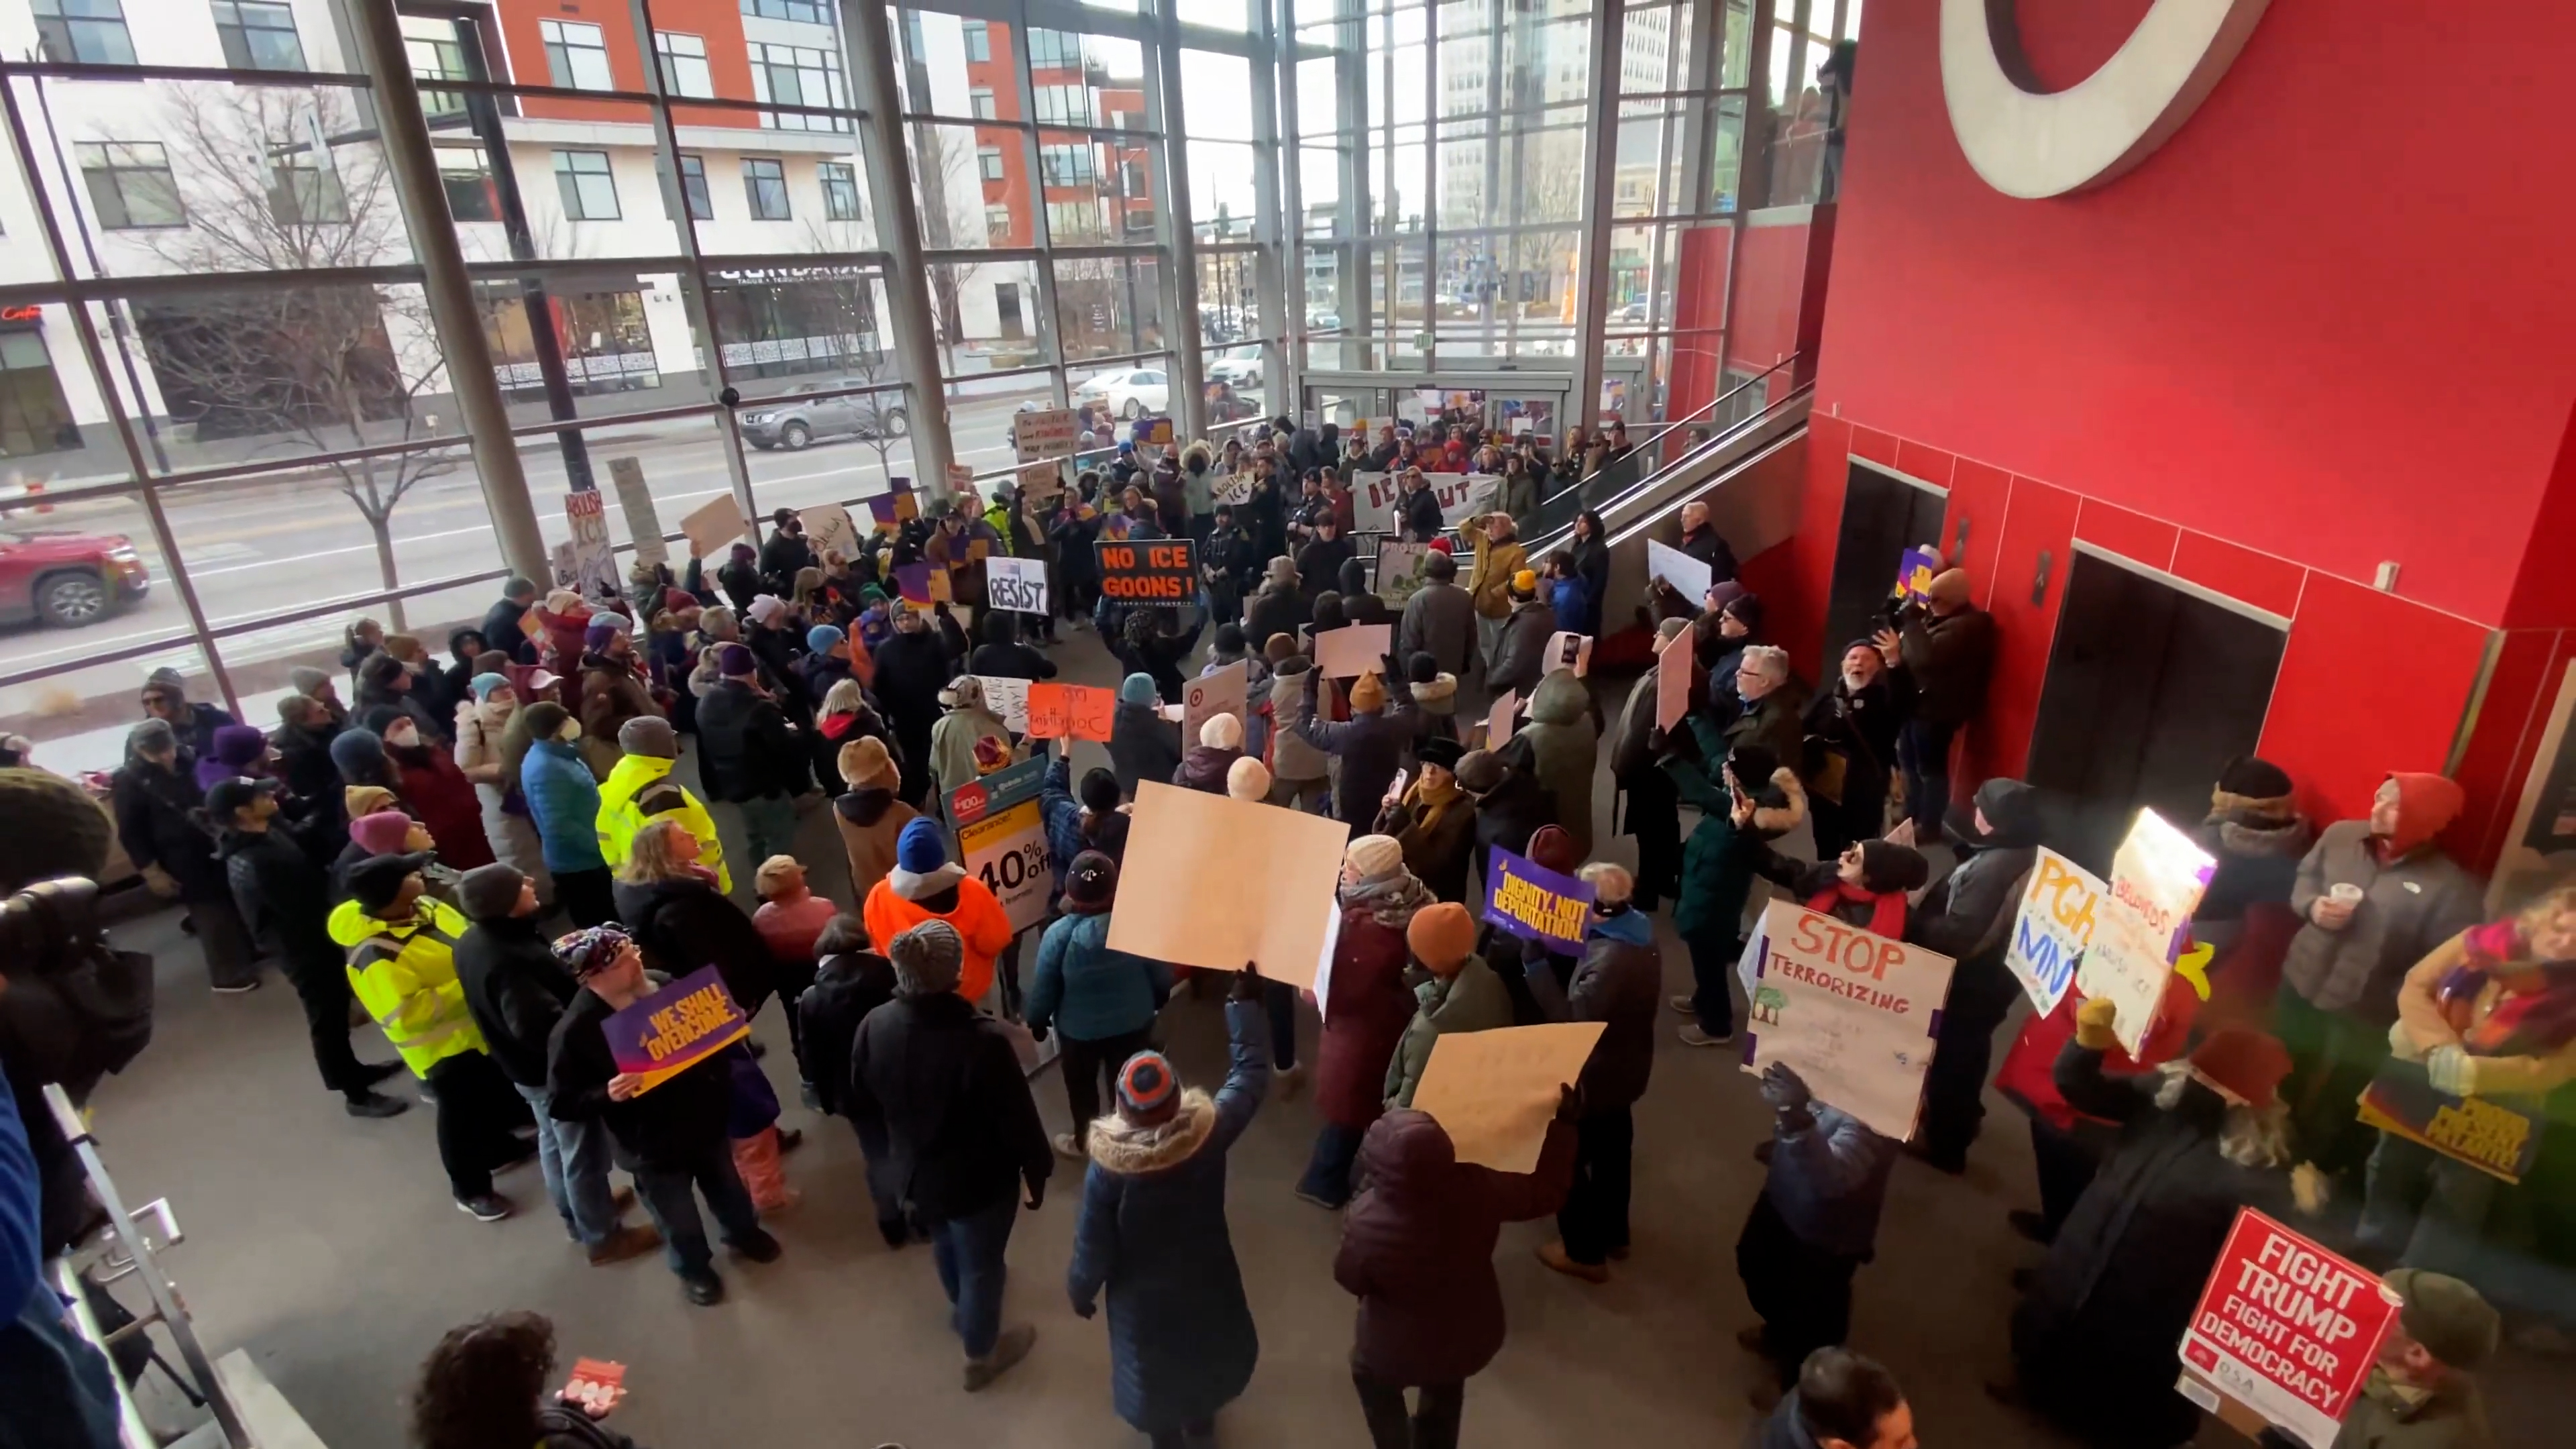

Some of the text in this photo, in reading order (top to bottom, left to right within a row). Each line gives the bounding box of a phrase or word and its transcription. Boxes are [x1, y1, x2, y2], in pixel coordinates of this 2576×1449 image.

[1228, 483, 1248, 502] ICE
[1102, 546, 1189, 570] NO ICE
[989, 577, 1044, 612] RESIST
[1493, 887, 1585, 944] DEPORTATION.
[1554, 894, 1590, 924] NOT
[1790, 913, 1906, 981] STOP
[2017, 914, 2074, 996] MN
[648, 983, 728, 1036] WE SHALL
[1770, 951, 1911, 1015] TERRORIZING
[2236, 1257, 2357, 1345] TRUMP
[2258, 1232, 2365, 1310] FIGHT
[2200, 1311, 2341, 1409] DEMOCRACY
[2222, 1293, 2339, 1377] FIGHT FOR
